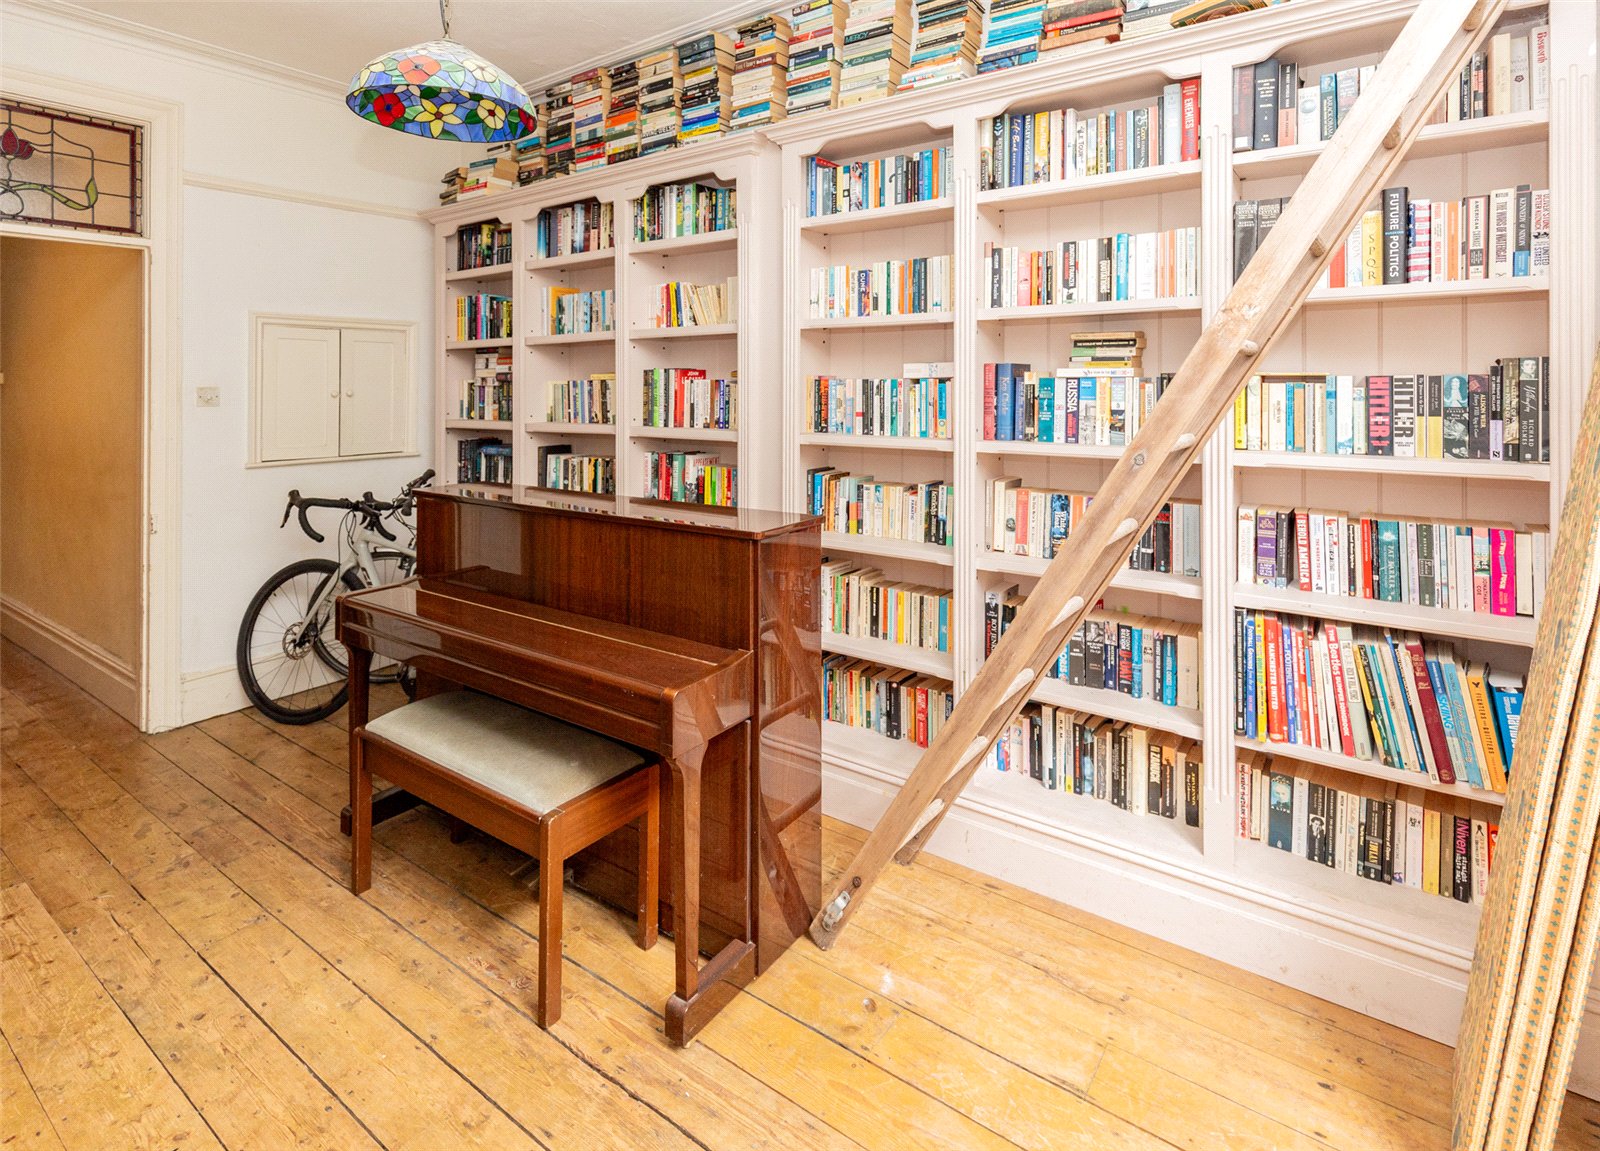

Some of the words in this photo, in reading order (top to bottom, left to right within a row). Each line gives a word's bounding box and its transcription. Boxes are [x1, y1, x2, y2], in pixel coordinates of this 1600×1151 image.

[1537, 32, 1549, 63] Bosworth
[1184, 98, 1194, 128] ENEMIES
[1390, 193, 1399, 230] FUTURE
[1496, 202, 1507, 211] THE
[1496, 211, 1507, 226] WARS
[1519, 197, 1527, 222] KENNEDY
[1390, 236, 1399, 277] POLITICS
[1496, 234, 1507, 263] WATERGATE
[1067, 379, 1077, 413] RUSSIA
[1369, 377, 1390, 437] HITLER
[1394, 378, 1413, 437] HITLER
[1297, 519, 1308, 545] BEHOLD
[1387, 546, 1395, 559] PAT
[1498, 542, 1507, 555] TWO
[1298, 546, 1310, 583] AMERICA
[1388, 561, 1396, 588] BARKER
[1328, 629, 1336, 641] THE
[1120, 650, 1132, 681] D-DAY
[1268, 643, 1276, 685] MANCHESTER
[1329, 643, 1341, 675] Beatles
[1335, 676, 1345, 702] BUMPER
[1339, 702, 1350, 736] SONGBOOK
[1437, 694, 1454, 730] SKIING
[1475, 693, 1486, 719] FIGHTERS
[1482, 727, 1495, 754] QUITTERS
[1150, 752, 1160, 784] ZANUCK
[1456, 824, 1469, 854] Niven
